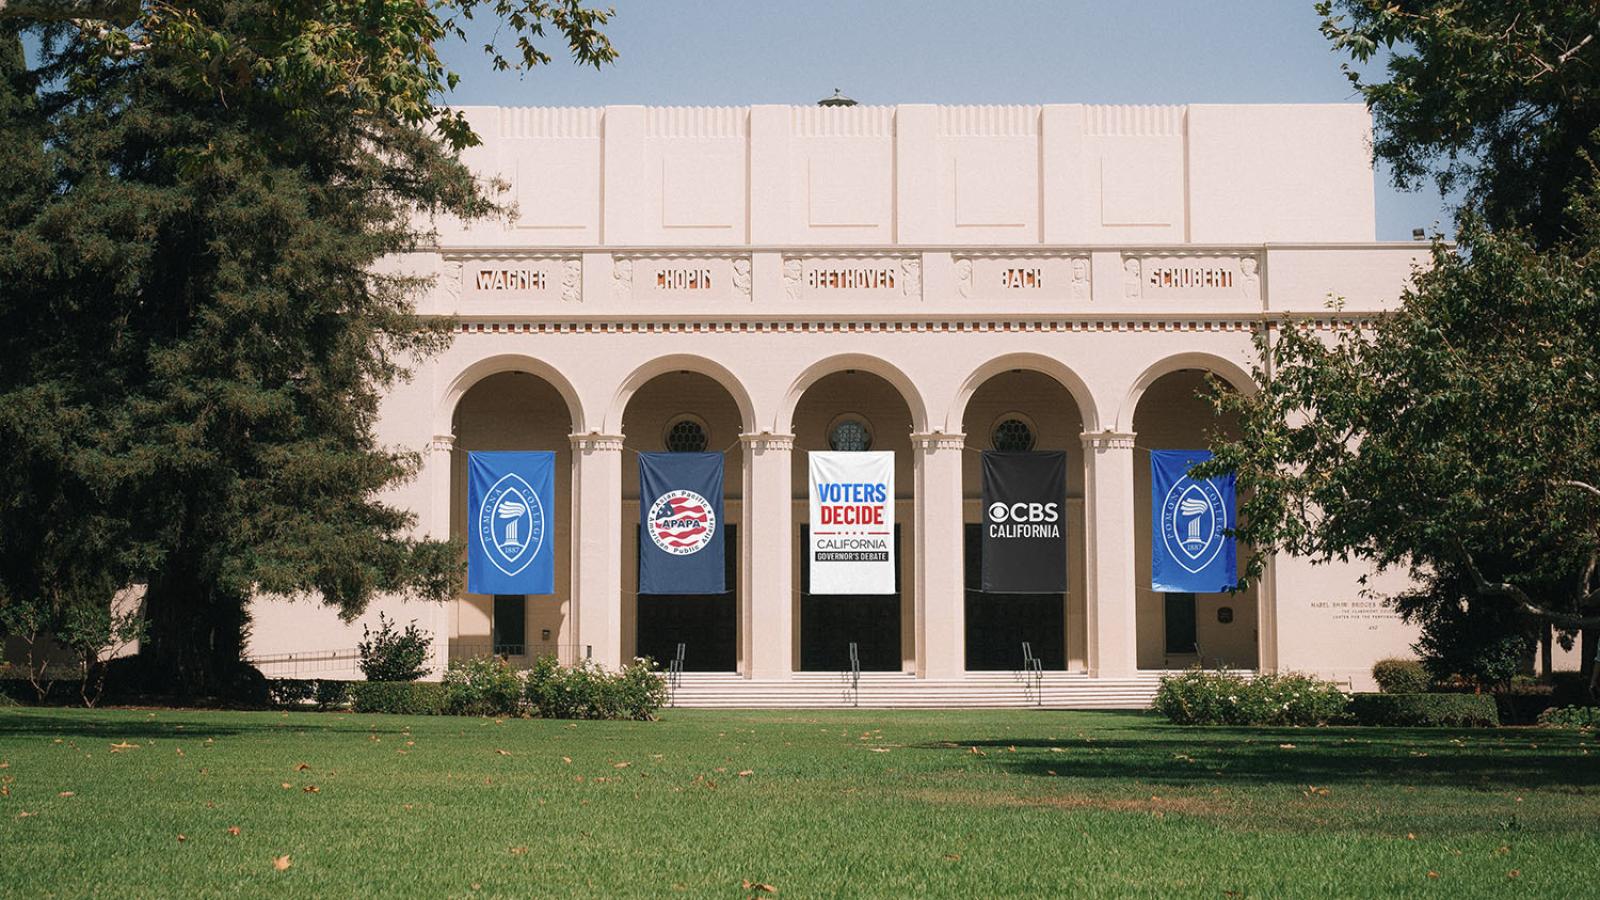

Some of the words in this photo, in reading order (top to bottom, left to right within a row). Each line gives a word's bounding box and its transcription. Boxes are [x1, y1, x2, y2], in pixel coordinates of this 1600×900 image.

[476, 270, 547, 290] WAGNER
[655, 269, 712, 289] CHOPIN
[807, 268, 896, 289] BEETHOVEN
[1000, 268, 1042, 288] BACH
[1150, 267, 1233, 288] SCHUBERT
[655, 491, 677, 508] Asian
[681, 490, 708, 509] Pacific
[818, 483, 887, 503] VOTERS
[482, 487, 502, 542] POMONA
[522, 487, 541, 543] COLLEGE
[821, 505, 884, 525] DECIDE
[1010, 502, 1059, 523] CBS
[1165, 486, 1185, 540] POMONA
[1204, 485, 1224, 541] COLLEGE
[662, 519, 701, 529] APAPA
[989, 524, 1060, 538] CALIFORNIA
[649, 516, 670, 551] American
[673, 544, 700, 554] Public
[701, 517, 715, 544] Affairs
[816, 539, 887, 550] CALIFORNIA
[817, 552, 860, 561] GOVERNOR'S
[860, 552, 887, 561] DEBATE
